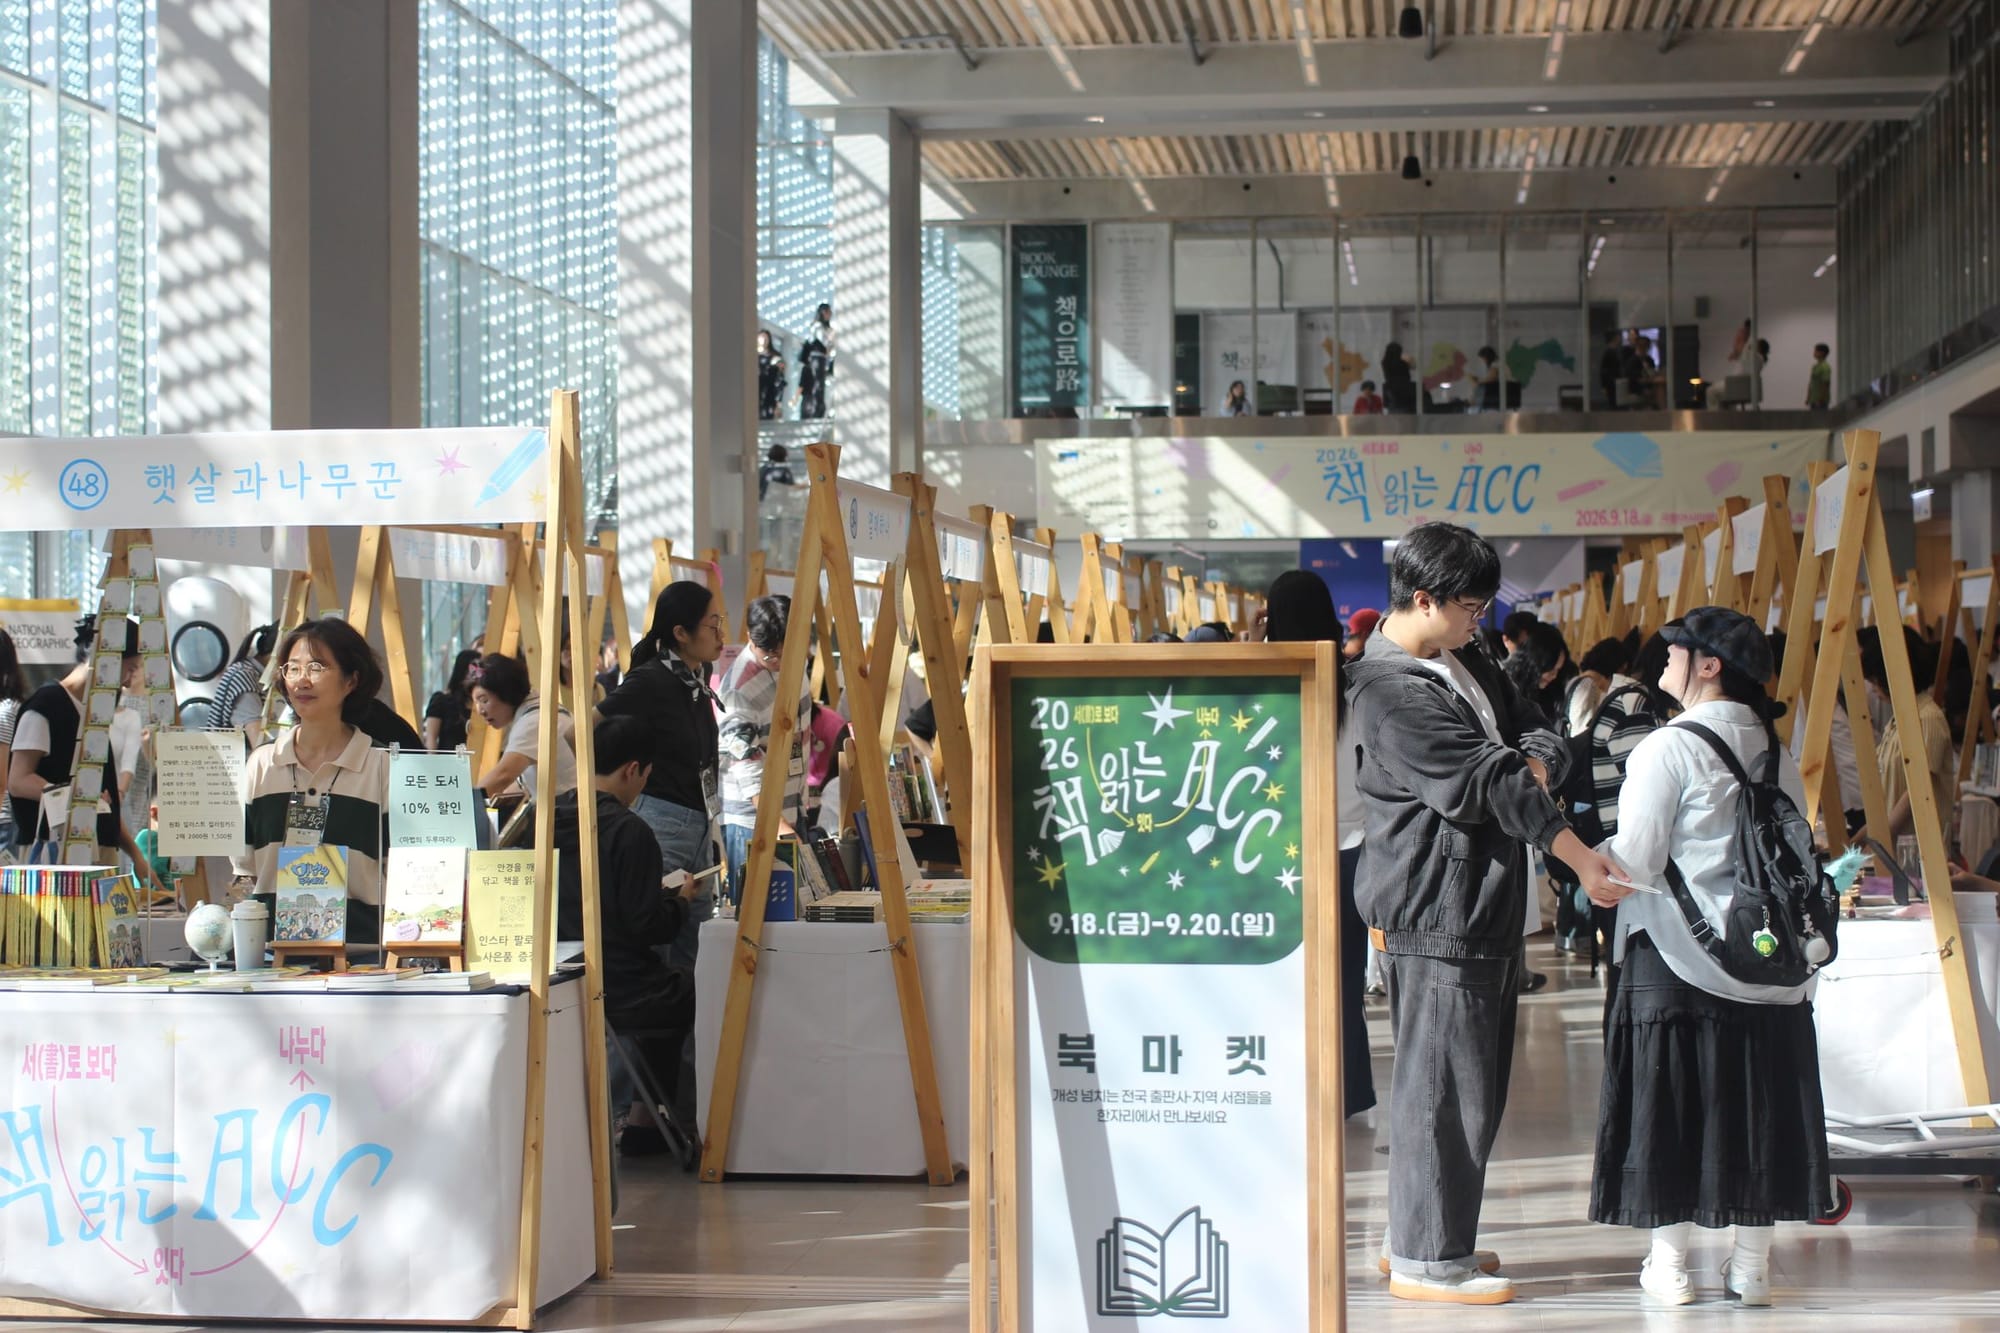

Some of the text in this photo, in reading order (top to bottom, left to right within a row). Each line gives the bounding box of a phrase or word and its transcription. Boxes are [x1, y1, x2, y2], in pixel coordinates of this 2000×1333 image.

[1020, 265, 1079, 278] LOUNGE
[1316, 447, 1359, 463] 2026
[68, 460, 403, 504] 48 햇살과나무꾼
[1323, 461, 1540, 523] 책 읽는 ACC
[1575, 508, 1653, 527] 2026.9.18.
[8, 624, 55, 636] NATIONAL
[1030, 696, 1070, 731] 20
[1040, 737, 1079, 770] 26
[404, 775, 459, 789] 모든 도서
[402, 801, 462, 816] 10% 할인
[1033, 740, 1282, 875] 책 읽는 ACC
[497, 863, 536, 873] 안경을 깨
[504, 876, 521, 886] 책을
[524, 876, 535, 885] 읽
[479, 935, 535, 947] 인스타 팔로
[483, 951, 512, 962] 사은품
[279, 1026, 326, 1065] 나누다
[22, 1043, 117, 1082] 서(書)로 보다
[1053, 1088, 1078, 1103] 개성
[1081, 1088, 1119, 1104] 넘치는
[1122, 1089, 1147, 1104] 전국
[1221, 1090, 1272, 1106] 서점들을
[1096, 1108, 1227, 1124] 한자리에서 만나보세요
[78, 1128, 187, 1242] 읽는
[193, 1093, 393, 1246] ACC
[154, 1247, 185, 1286] 잇다
